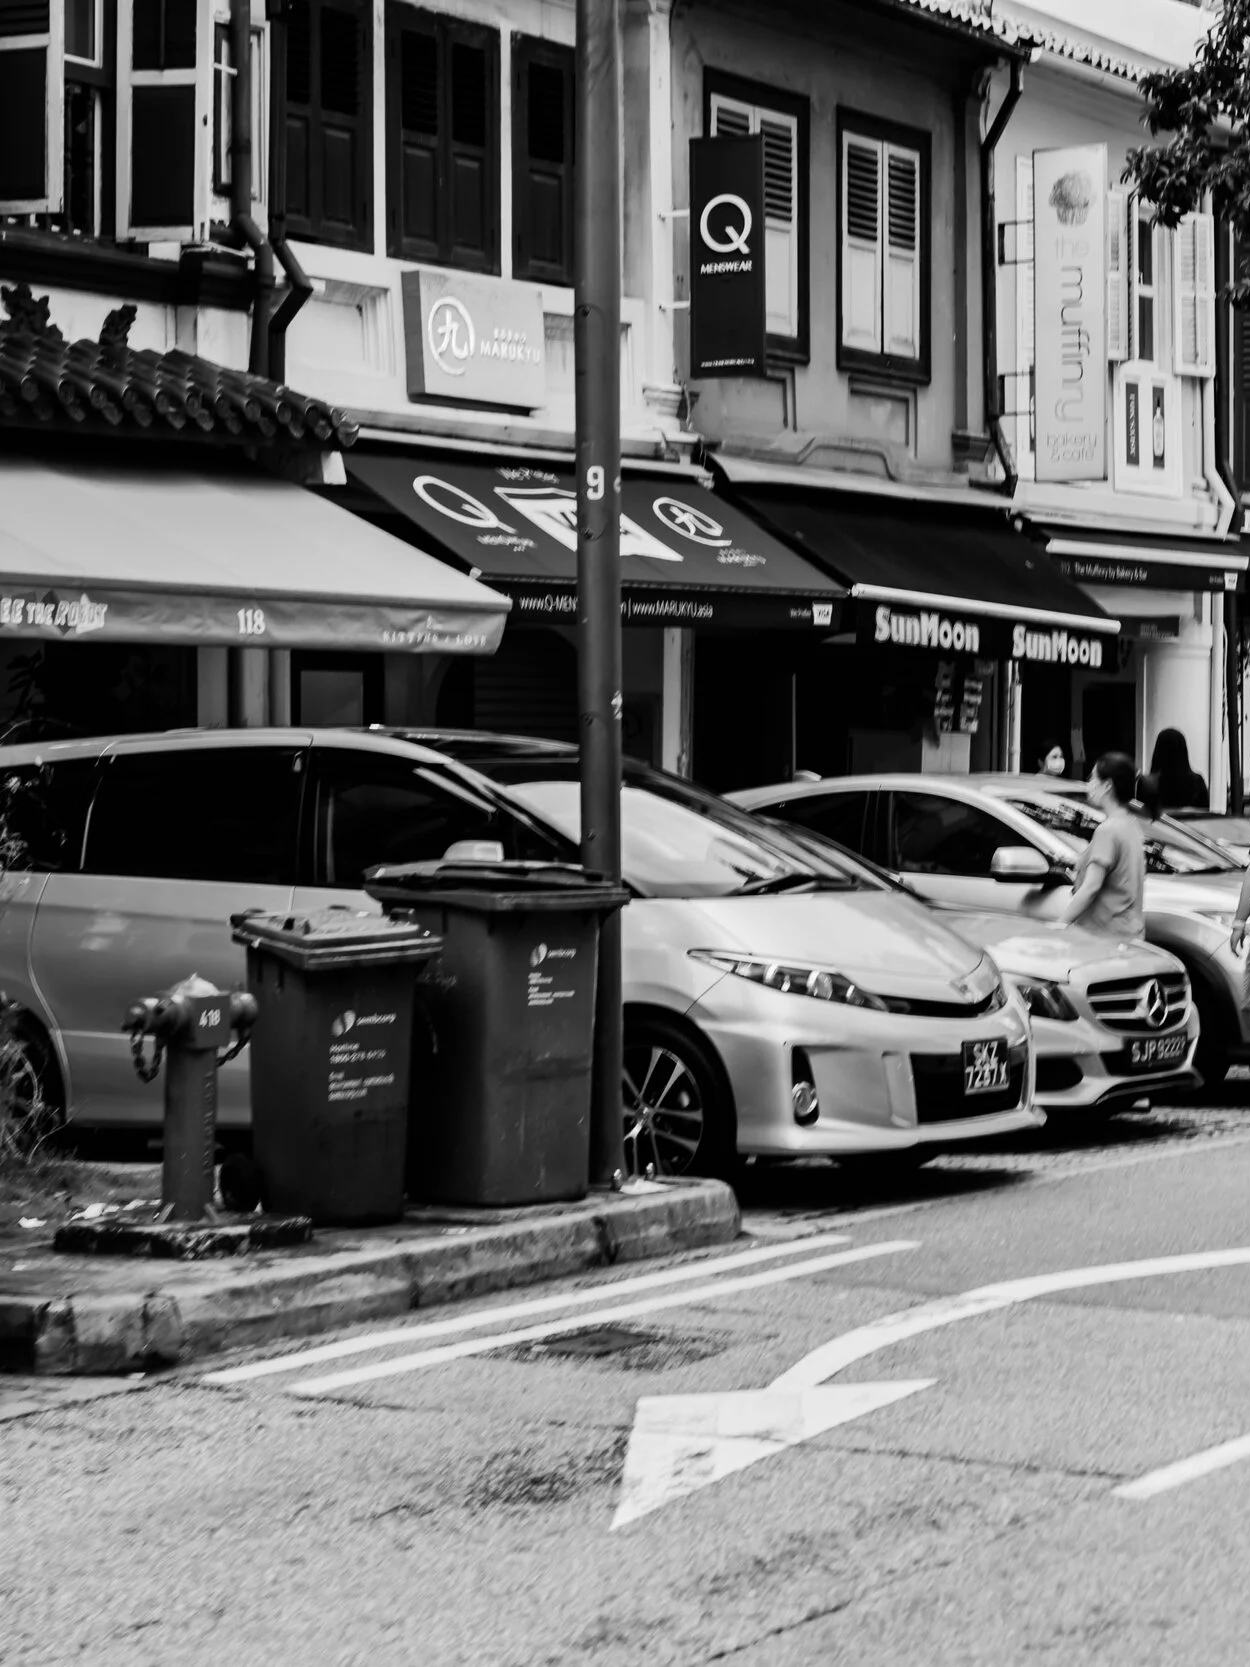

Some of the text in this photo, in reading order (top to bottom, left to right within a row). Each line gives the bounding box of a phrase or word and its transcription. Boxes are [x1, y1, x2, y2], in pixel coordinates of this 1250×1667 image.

[700, 193, 752, 255] Q
[700, 260, 753, 275] MENSWEAR
[480, 340, 541, 365] MARUKYU
[586, 465, 605, 501] 9
[413, 475, 518, 534] Q
[26, 602, 55, 625] THE
[237, 608, 266, 635] 118
[875, 605, 980, 654] SunMoon
[1012, 623, 1103, 668] SunMoon
